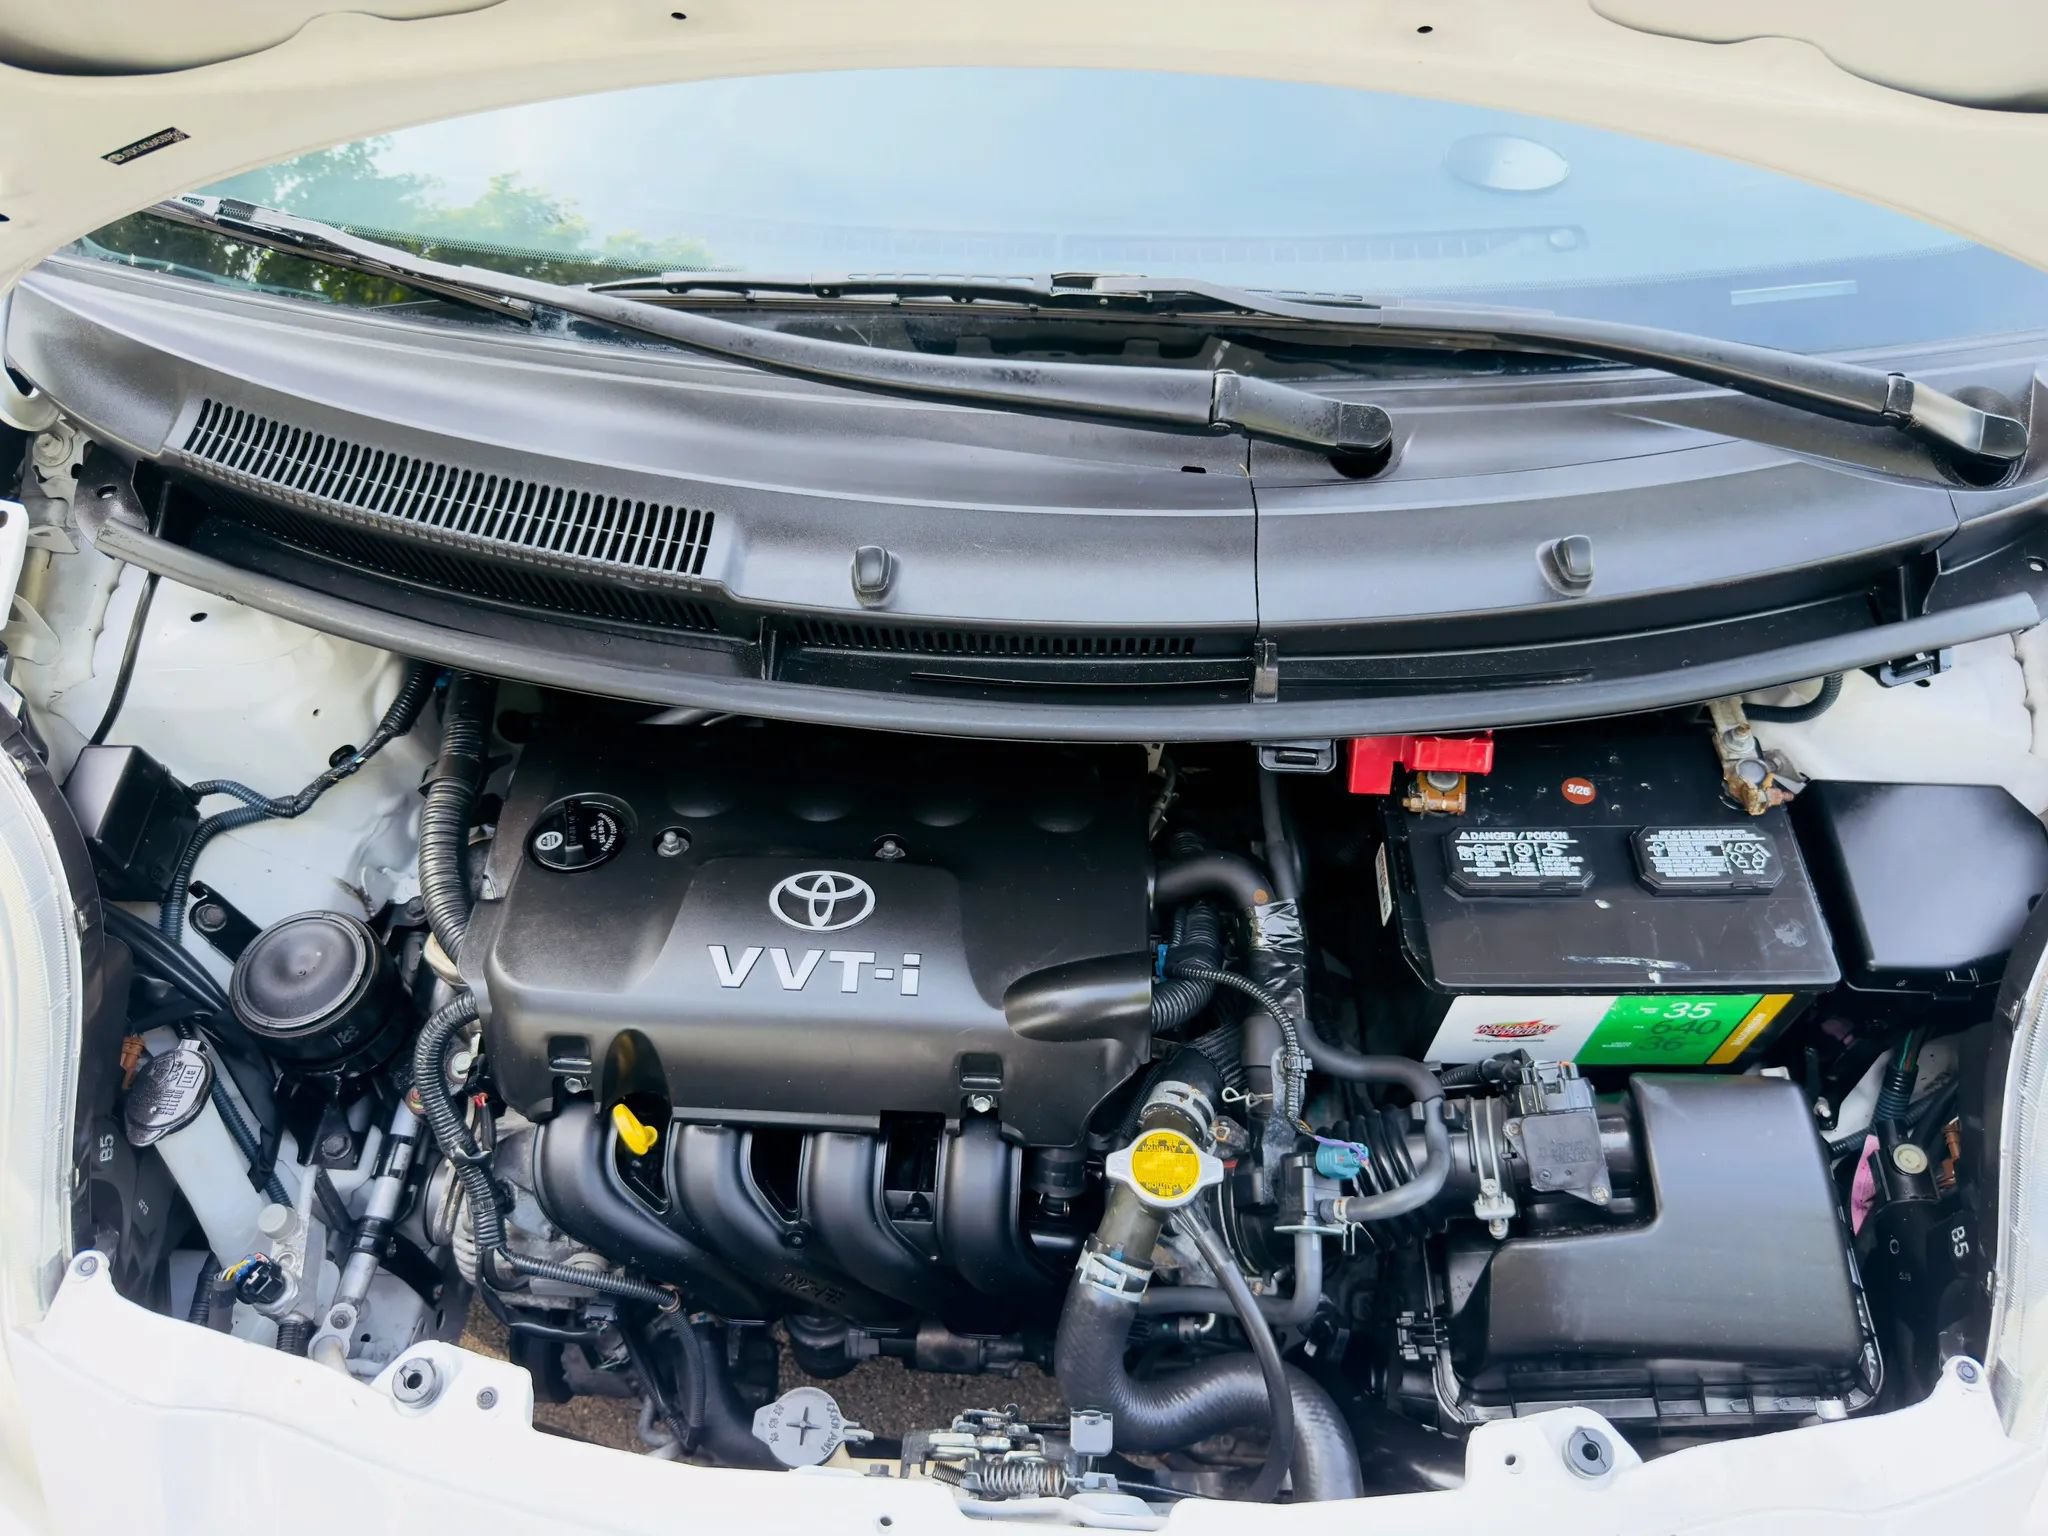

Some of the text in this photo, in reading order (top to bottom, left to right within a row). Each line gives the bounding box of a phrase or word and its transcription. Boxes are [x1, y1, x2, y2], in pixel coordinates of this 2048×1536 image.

[1470, 831, 1517, 840] DANGER
[1527, 831, 1569, 840] POISON
[707, 944, 922, 996] VVT-i
[1663, 1001, 1718, 1018] 35
[1650, 1019, 1721, 1035] 640
[1638, 1036, 1684, 1051] 36
[100, 1134, 114, 1162] B5
[1951, 1226, 1969, 1257] B5
